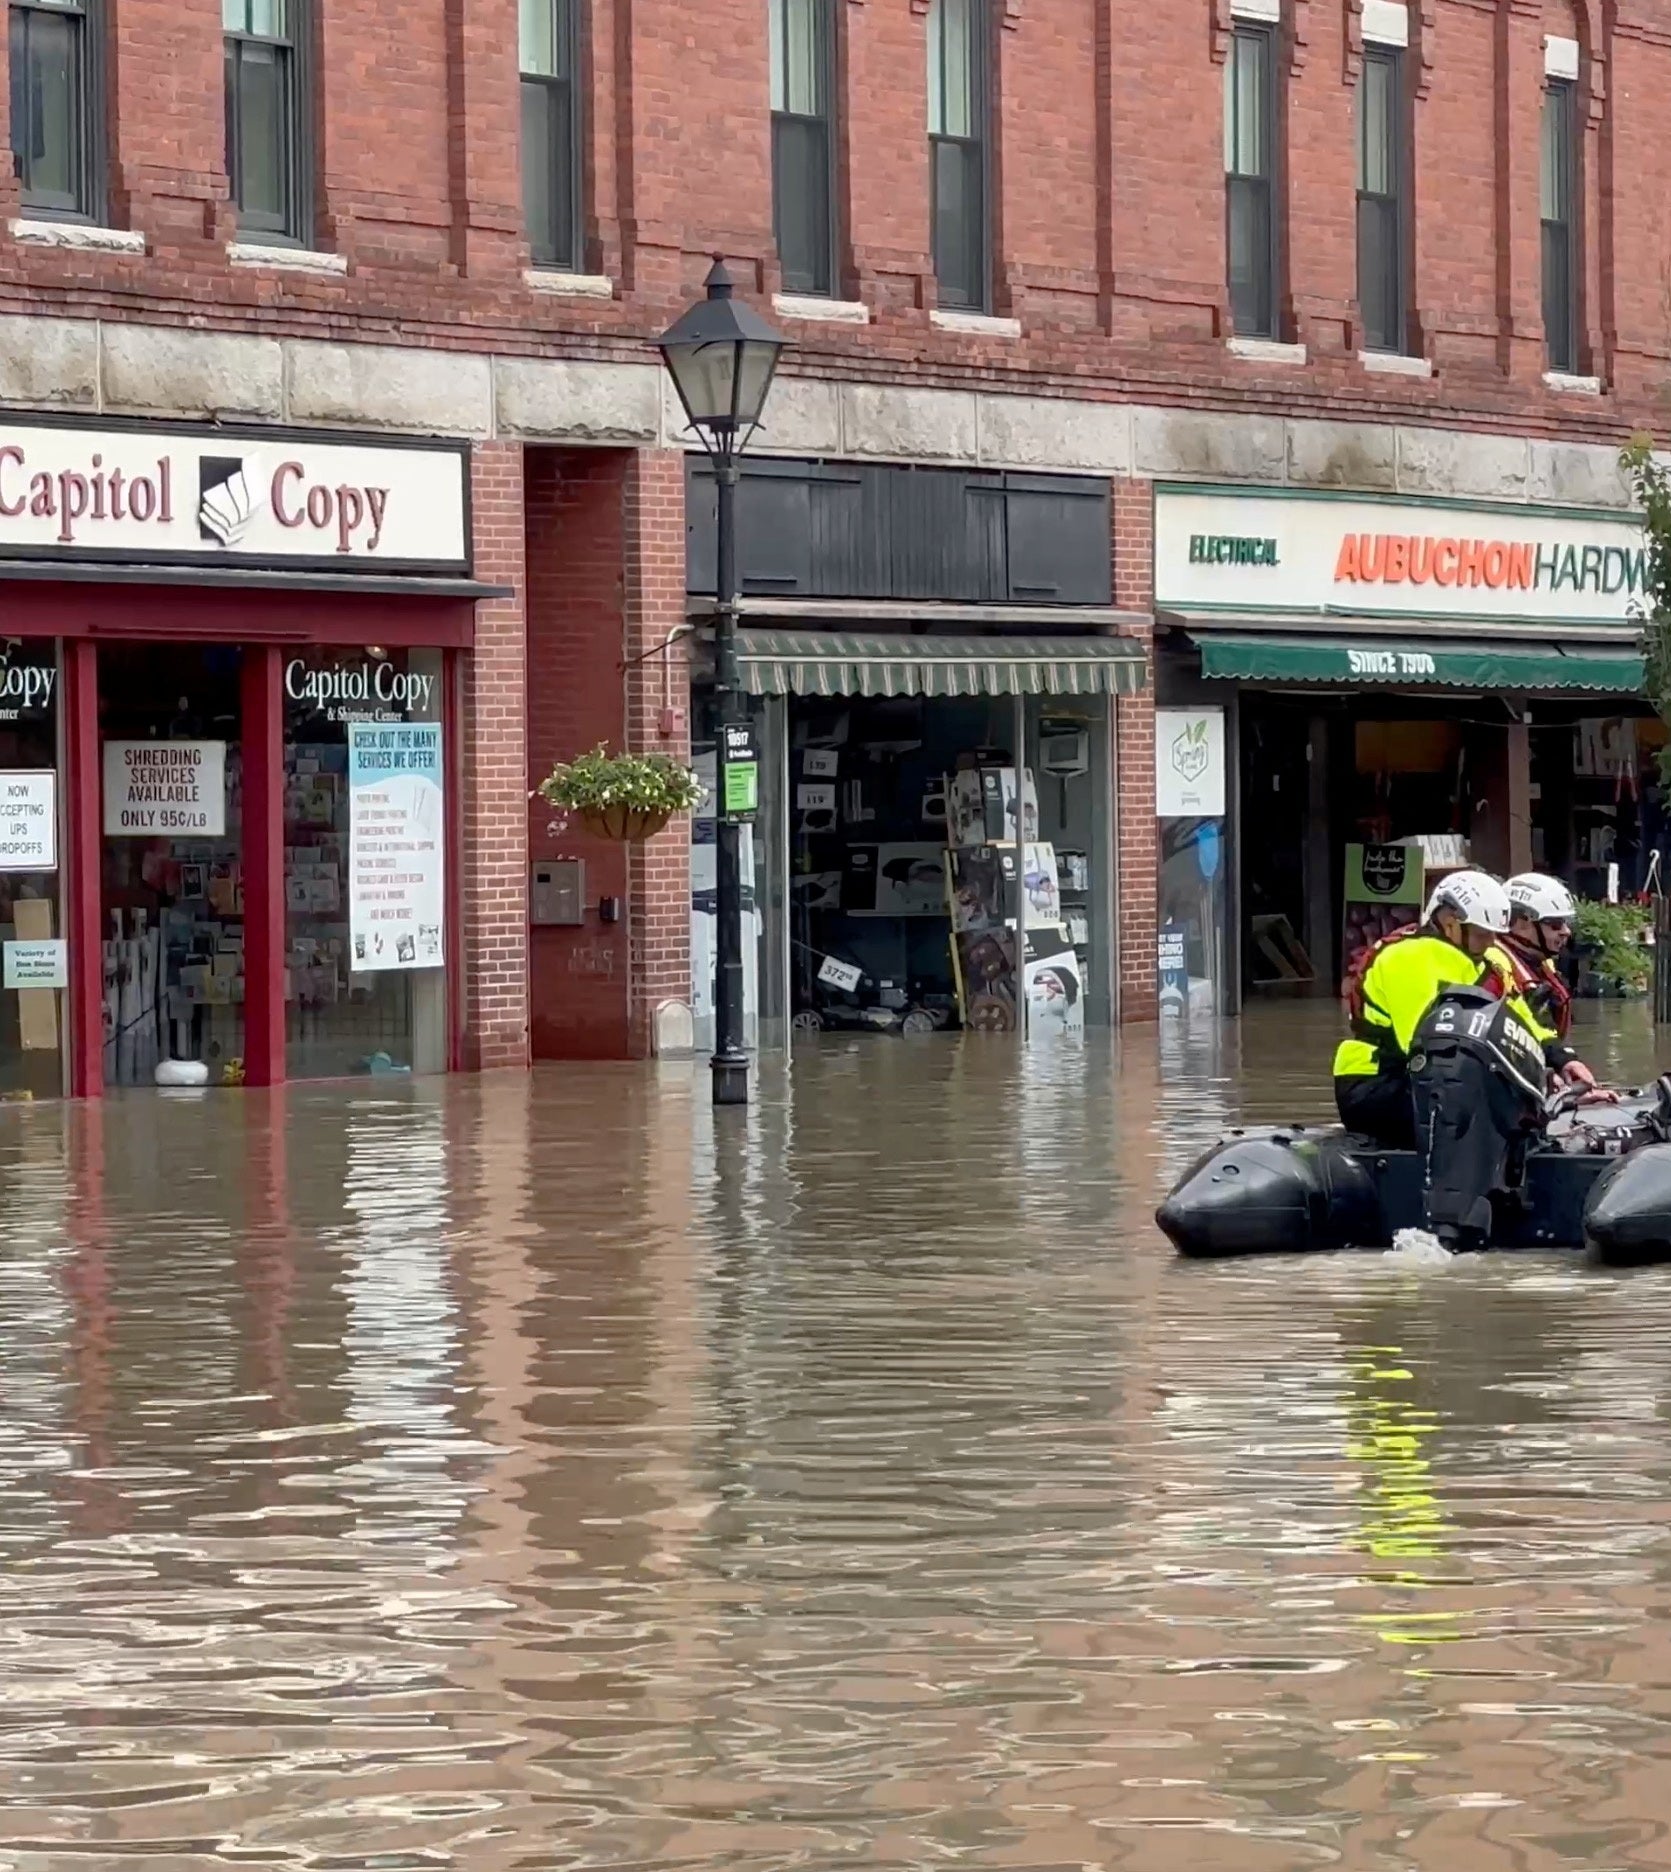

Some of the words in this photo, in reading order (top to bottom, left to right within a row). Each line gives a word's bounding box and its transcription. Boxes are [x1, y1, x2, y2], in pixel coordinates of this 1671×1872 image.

[0, 445, 174, 542] Capitol
[270, 461, 391, 553] Copy
[1189, 534, 1280, 566] ELECTRICAL
[1333, 533, 1536, 589] AUBUCHON
[1534, 541, 1651, 595] HARDW
[1349, 650, 1398, 674] SINCE
[285, 659, 370, 710] Capitol
[374, 662, 434, 712] Copy
[337, 706, 374, 723] Shipping
[374, 707, 403, 722] Center
[379, 731, 395, 748] OUT
[125, 749, 202, 766] SHREDDING
[131, 768, 196, 784] SERVICES
[8, 786, 30, 797] NOW
[128, 786, 199, 802] AVAILABLE
[0, 804, 44, 817] CCEPTING
[121, 810, 154, 827] ONLY
[10, 824, 28, 835] UPS
[0, 843, 43, 854] ROPOFFS
